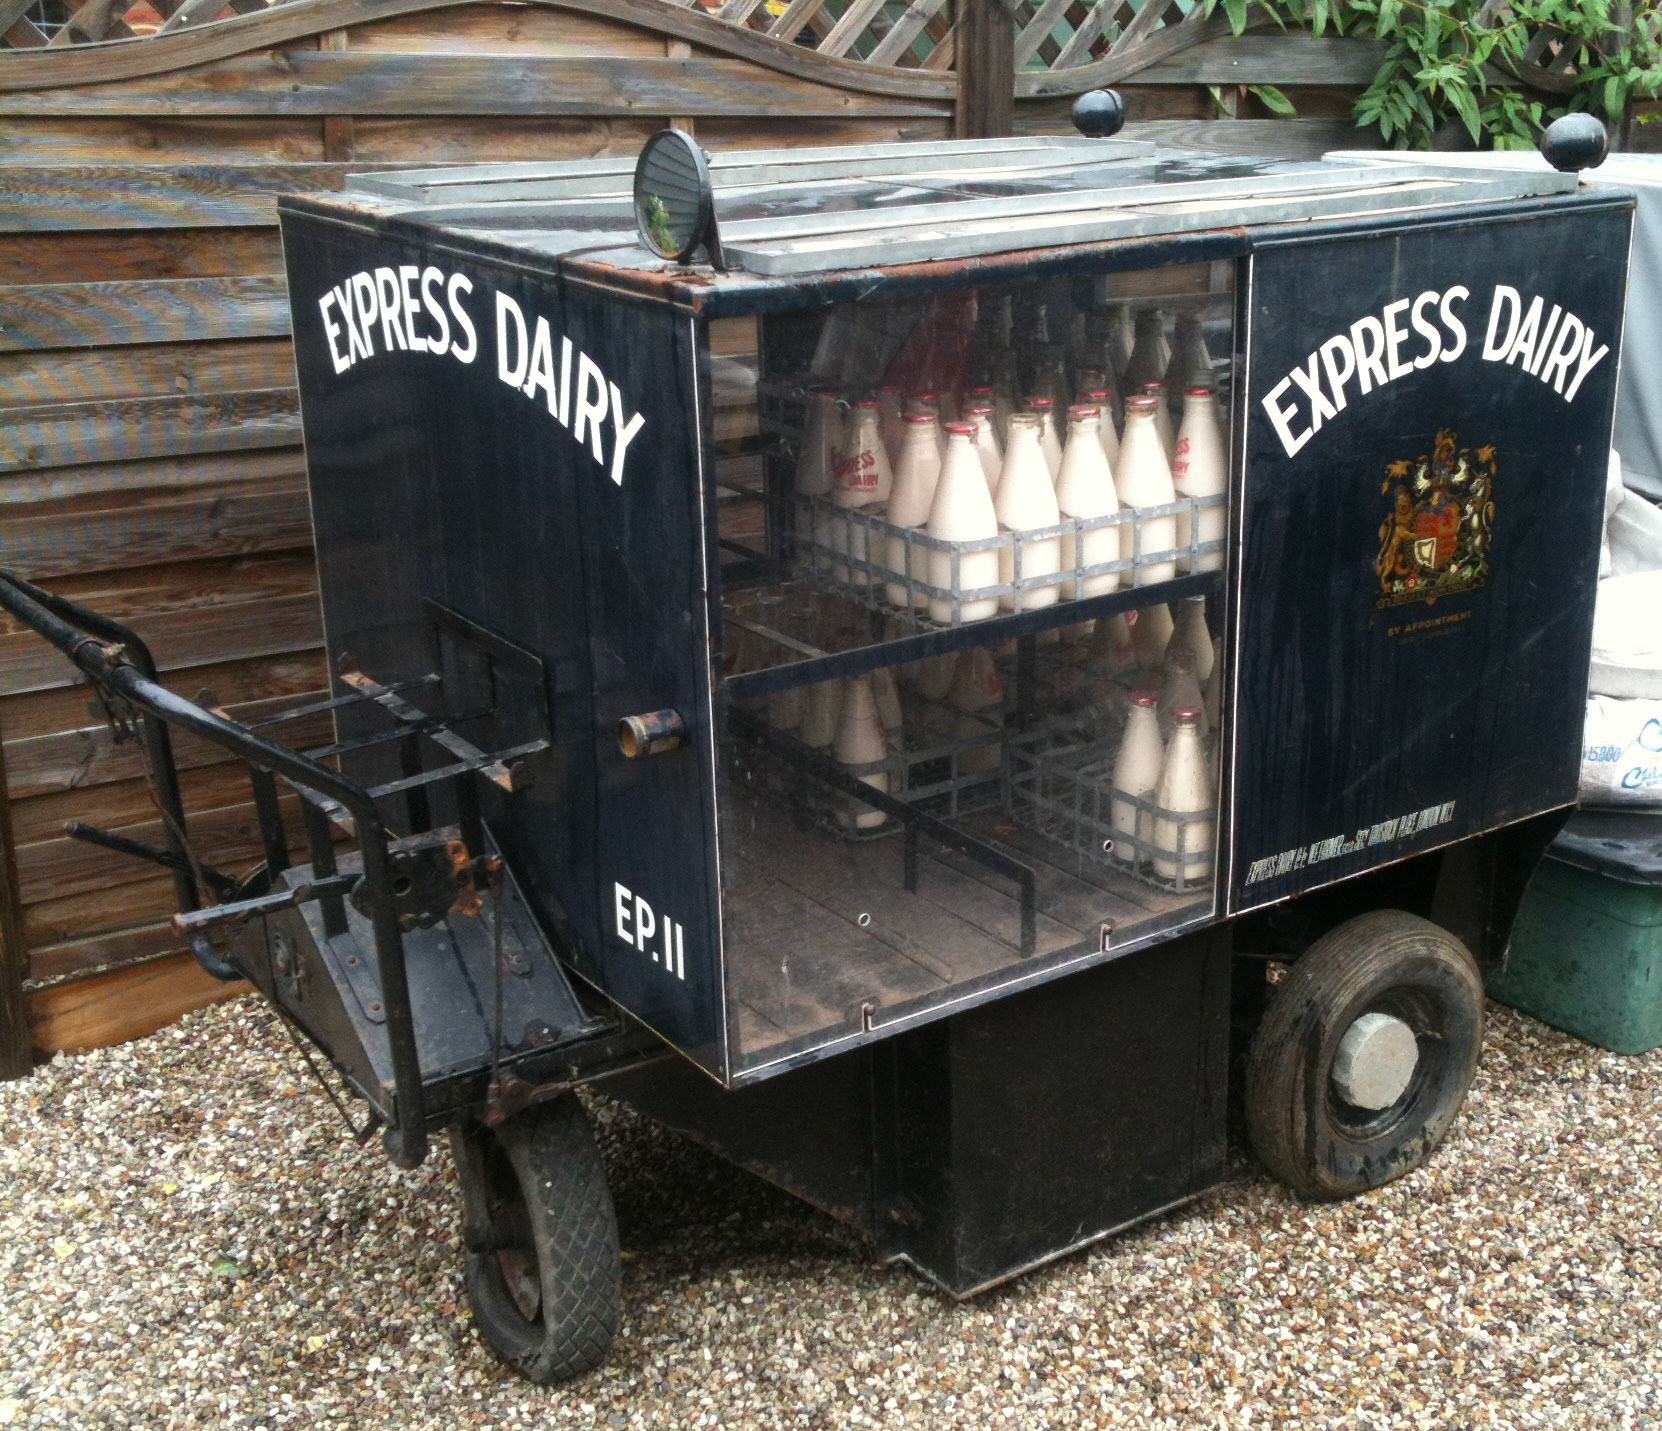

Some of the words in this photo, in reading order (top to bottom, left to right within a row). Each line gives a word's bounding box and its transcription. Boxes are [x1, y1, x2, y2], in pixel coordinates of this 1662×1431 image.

[318, 265, 478, 375] EXPRESS
[496, 290, 646, 487] DAIRY
[1261, 285, 1470, 459] EXPRESS
[1482, 284, 1609, 403] DAIRY
[1403, 611, 1472, 633] APPOINTMENT
